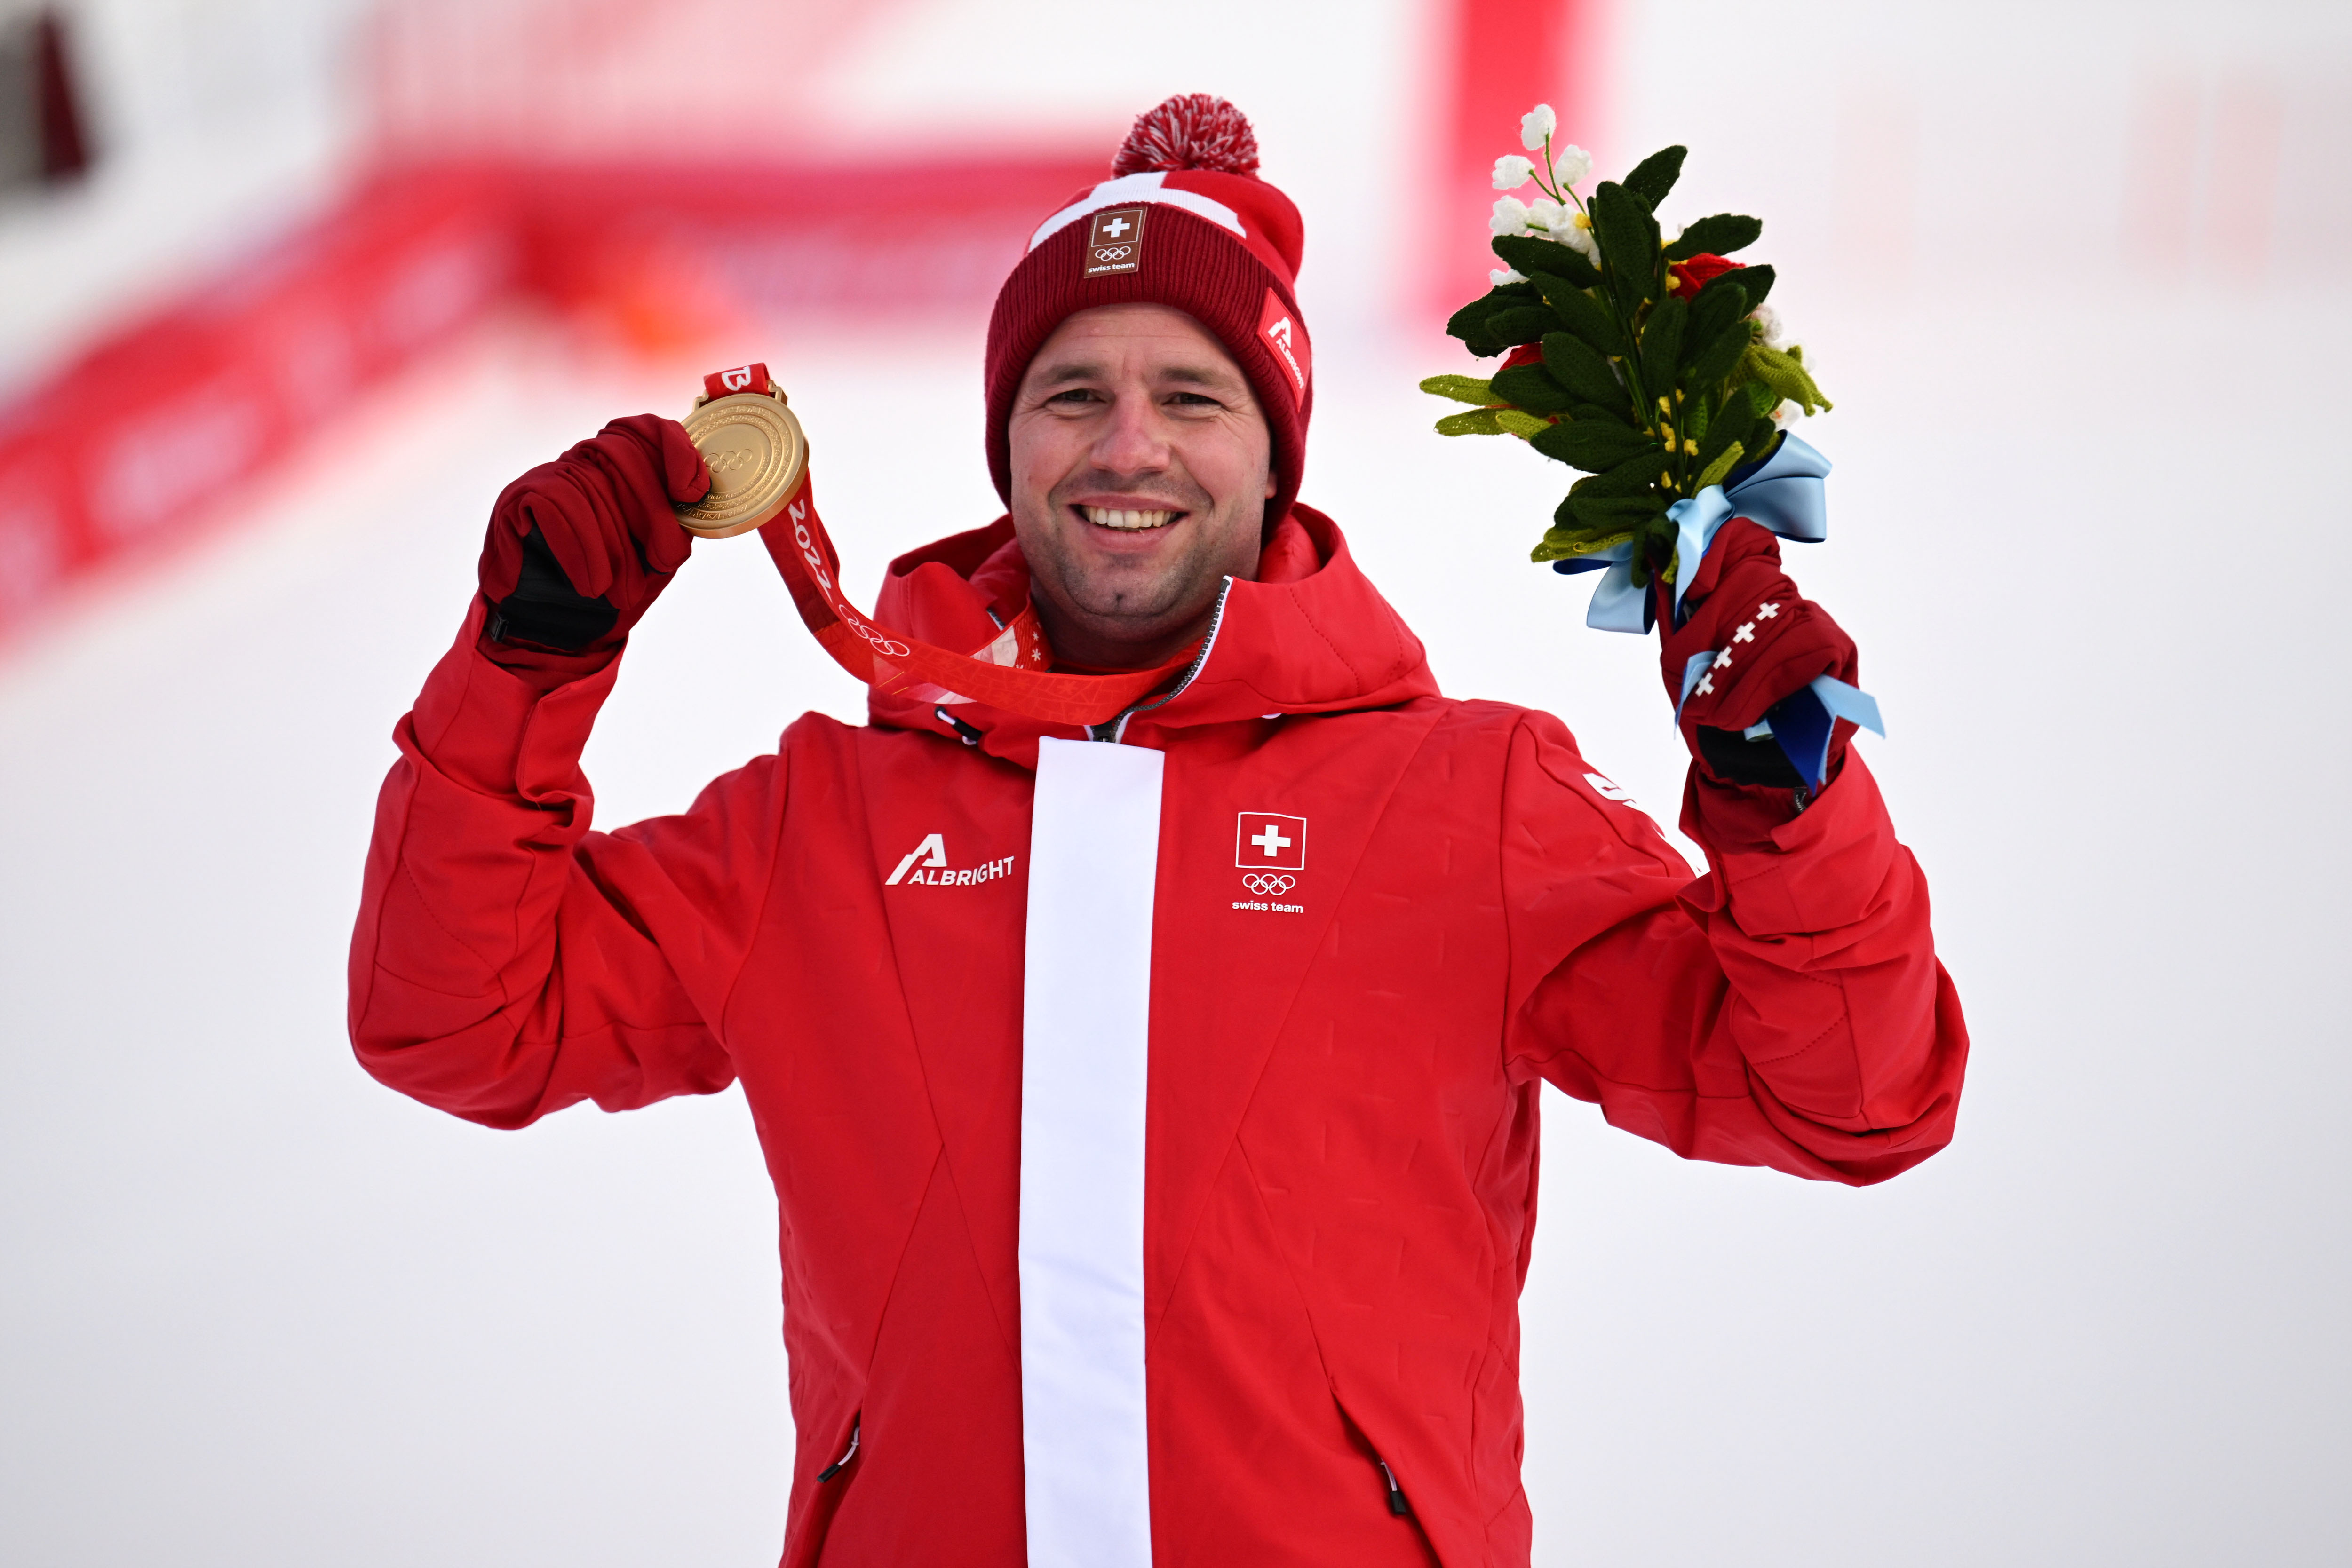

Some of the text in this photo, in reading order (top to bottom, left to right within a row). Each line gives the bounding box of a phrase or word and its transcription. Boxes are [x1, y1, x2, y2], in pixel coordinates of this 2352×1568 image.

[1276, 338, 1304, 389] ALBRIGHT
[788, 499, 833, 603] 2022
[907, 856, 1015, 886] ALBRIGHT
[1232, 900, 1303, 913] swiss team
